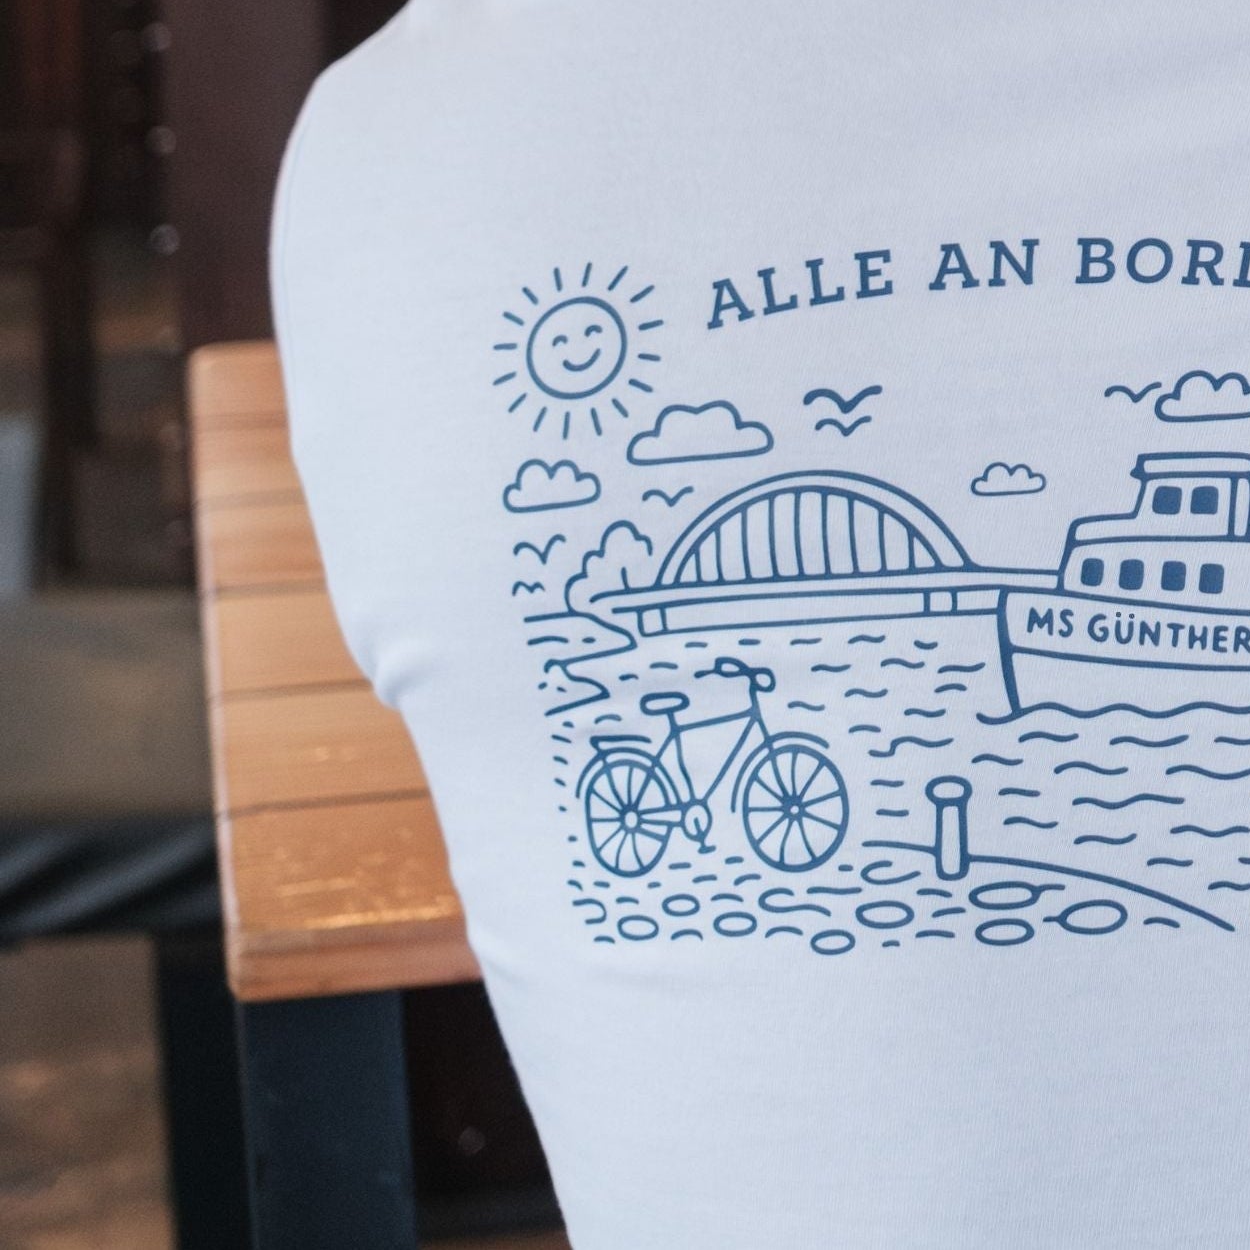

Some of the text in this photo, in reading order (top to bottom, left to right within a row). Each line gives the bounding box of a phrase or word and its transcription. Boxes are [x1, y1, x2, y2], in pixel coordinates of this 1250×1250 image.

[706, 249, 894, 331] ALLE
[928, 238, 1040, 291] AN
[1026, 606, 1075, 639] MS
